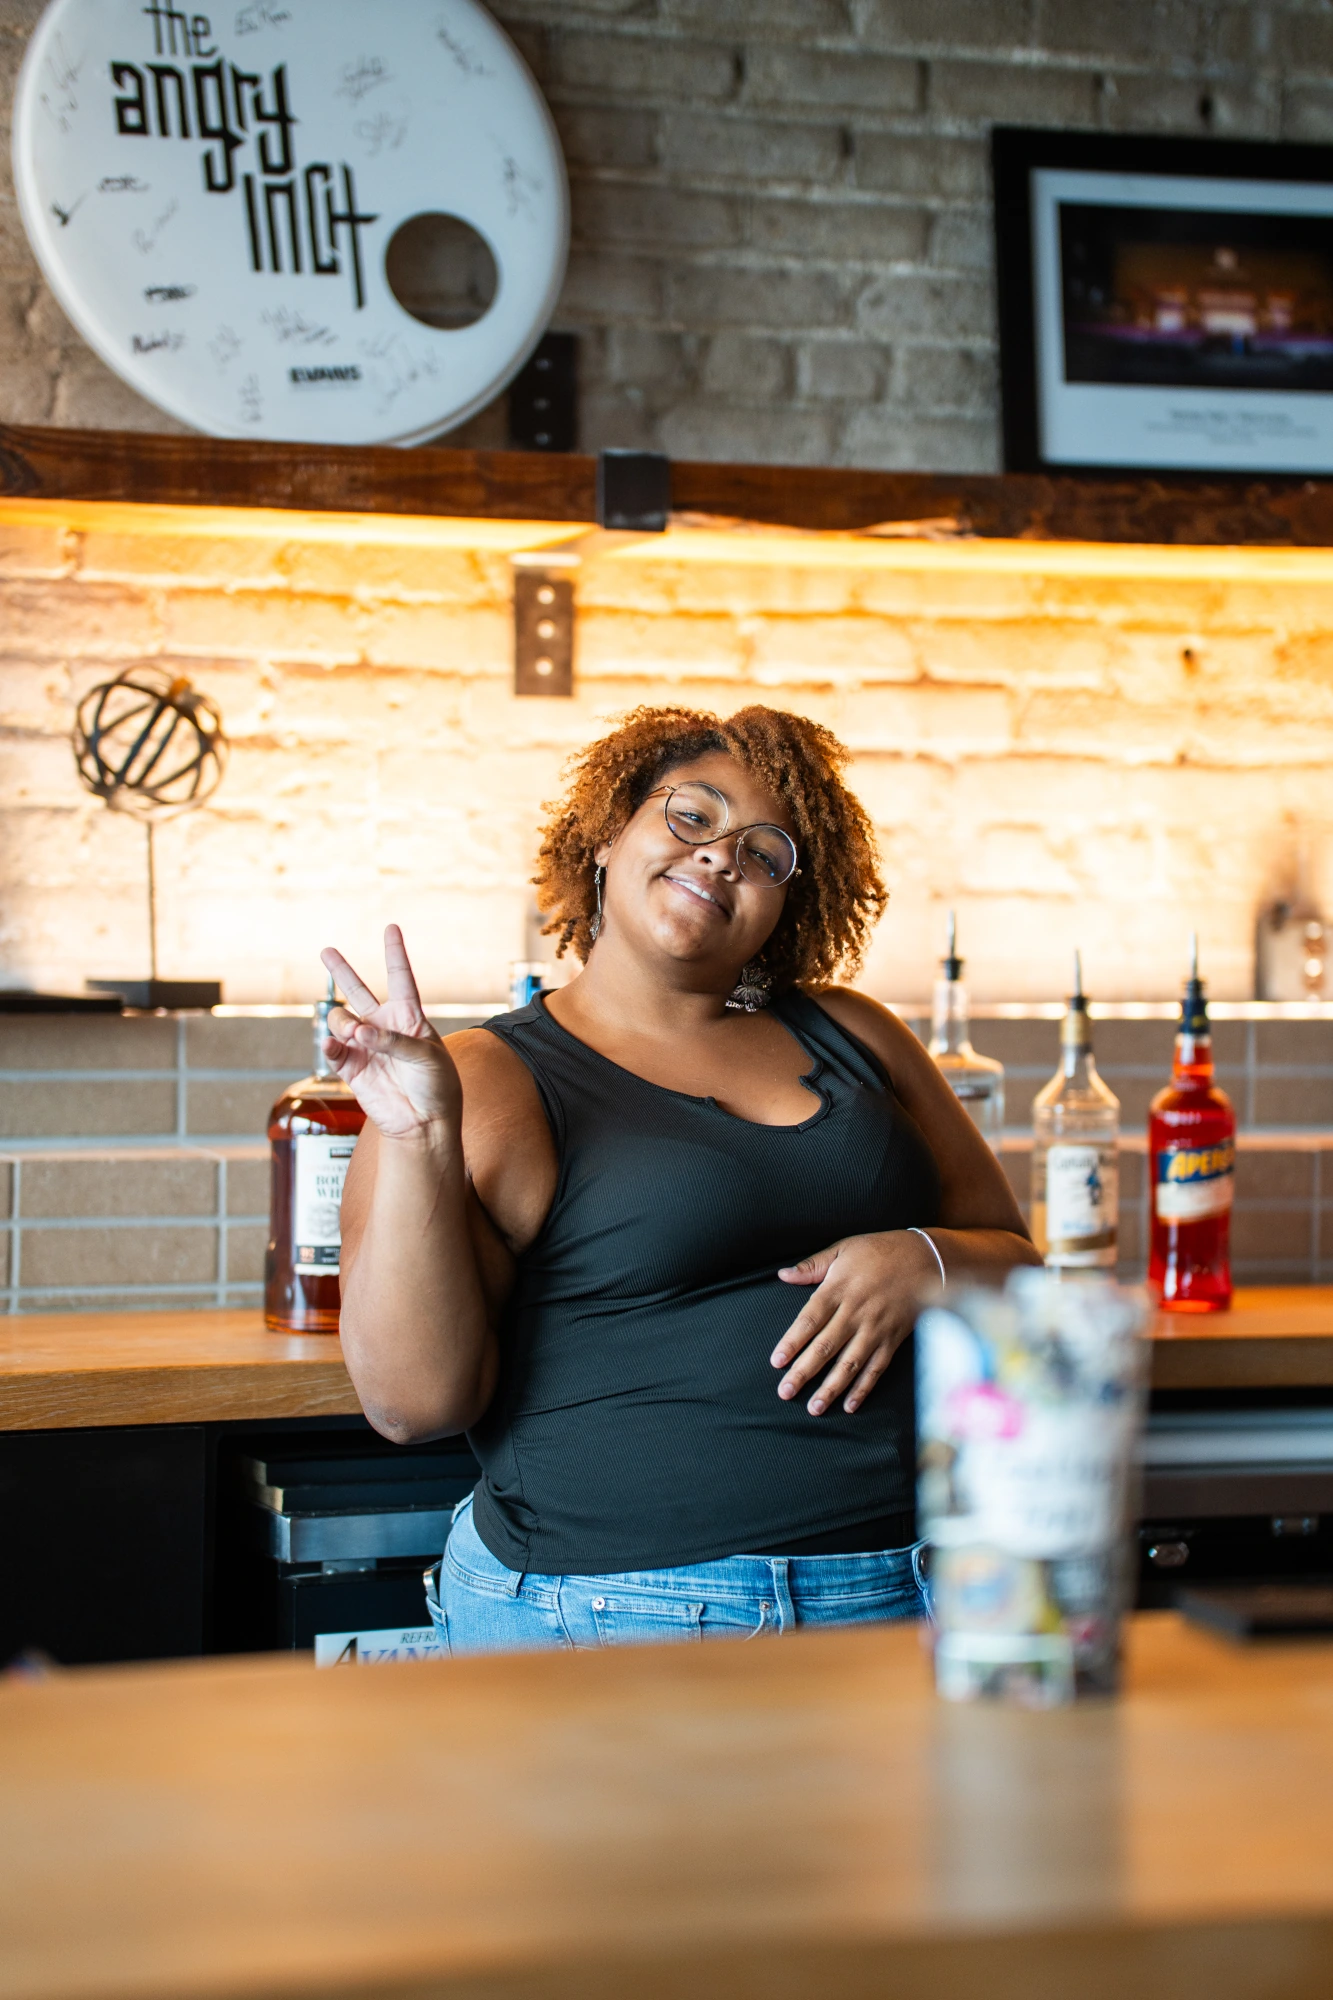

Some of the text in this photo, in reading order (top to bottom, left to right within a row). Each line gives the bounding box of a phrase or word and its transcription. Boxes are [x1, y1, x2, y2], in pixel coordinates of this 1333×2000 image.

[142, 0, 219, 57] the
[110, 57, 299, 193] angry
[333, 1636, 440, 1668] AVAN
